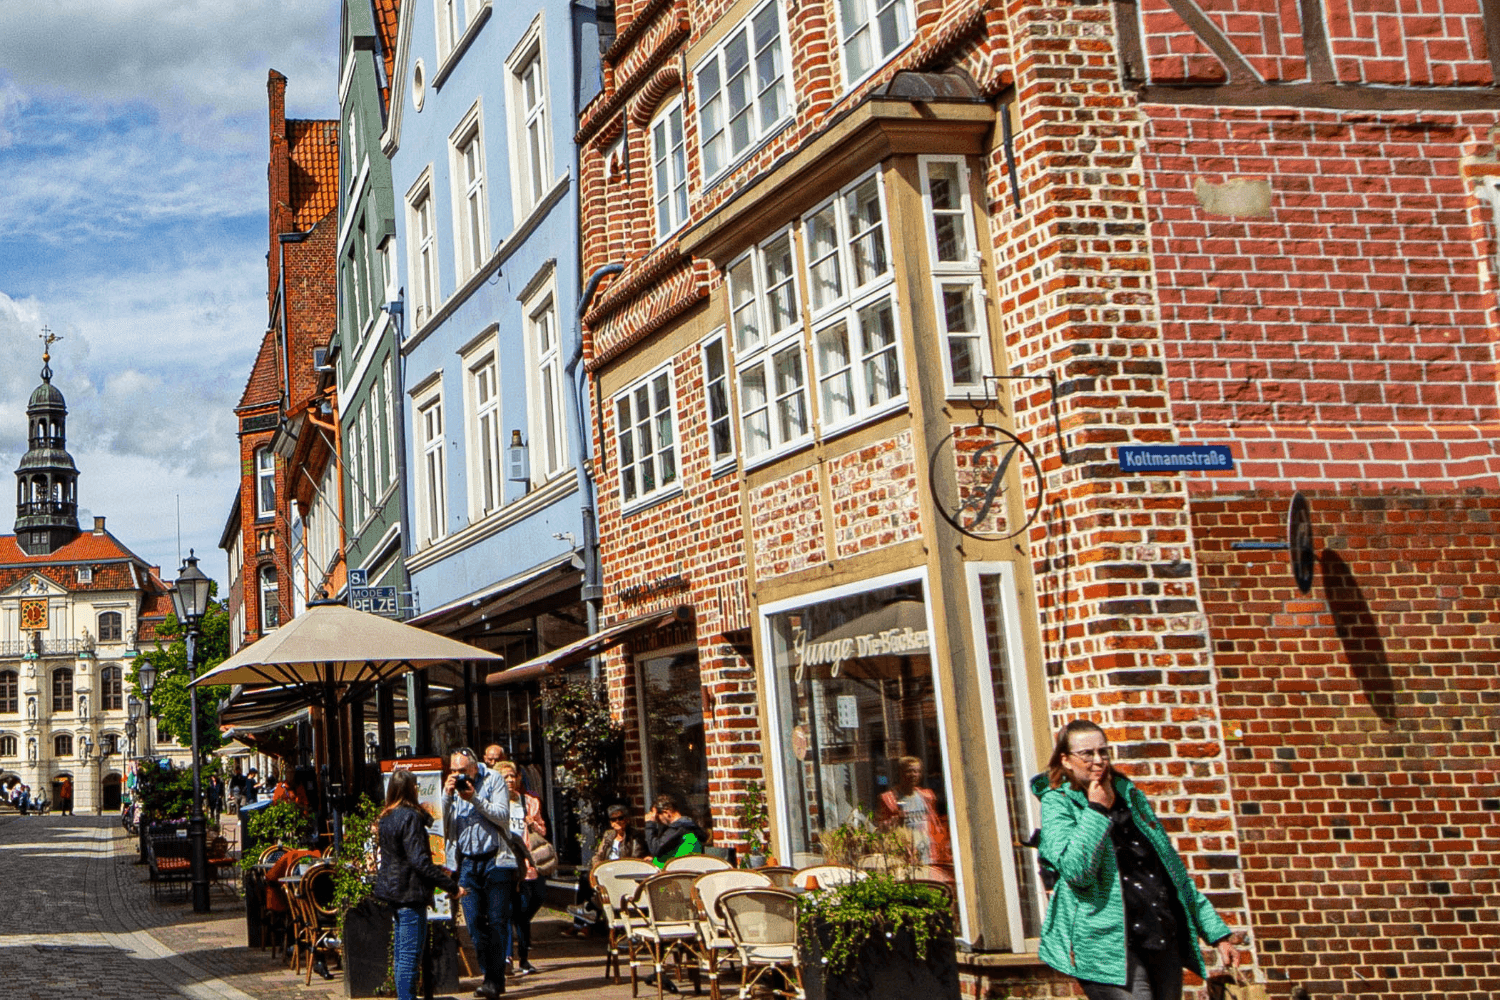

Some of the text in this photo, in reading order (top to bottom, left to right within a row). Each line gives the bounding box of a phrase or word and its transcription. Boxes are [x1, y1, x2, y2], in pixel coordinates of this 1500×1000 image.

[1125, 450, 1227, 467] Koltmannstraße
[352, 588, 396, 598] MODE &
[353, 598, 396, 613] PELZE
[794, 629, 854, 684] Junge
[855, 633, 881, 658] Die
